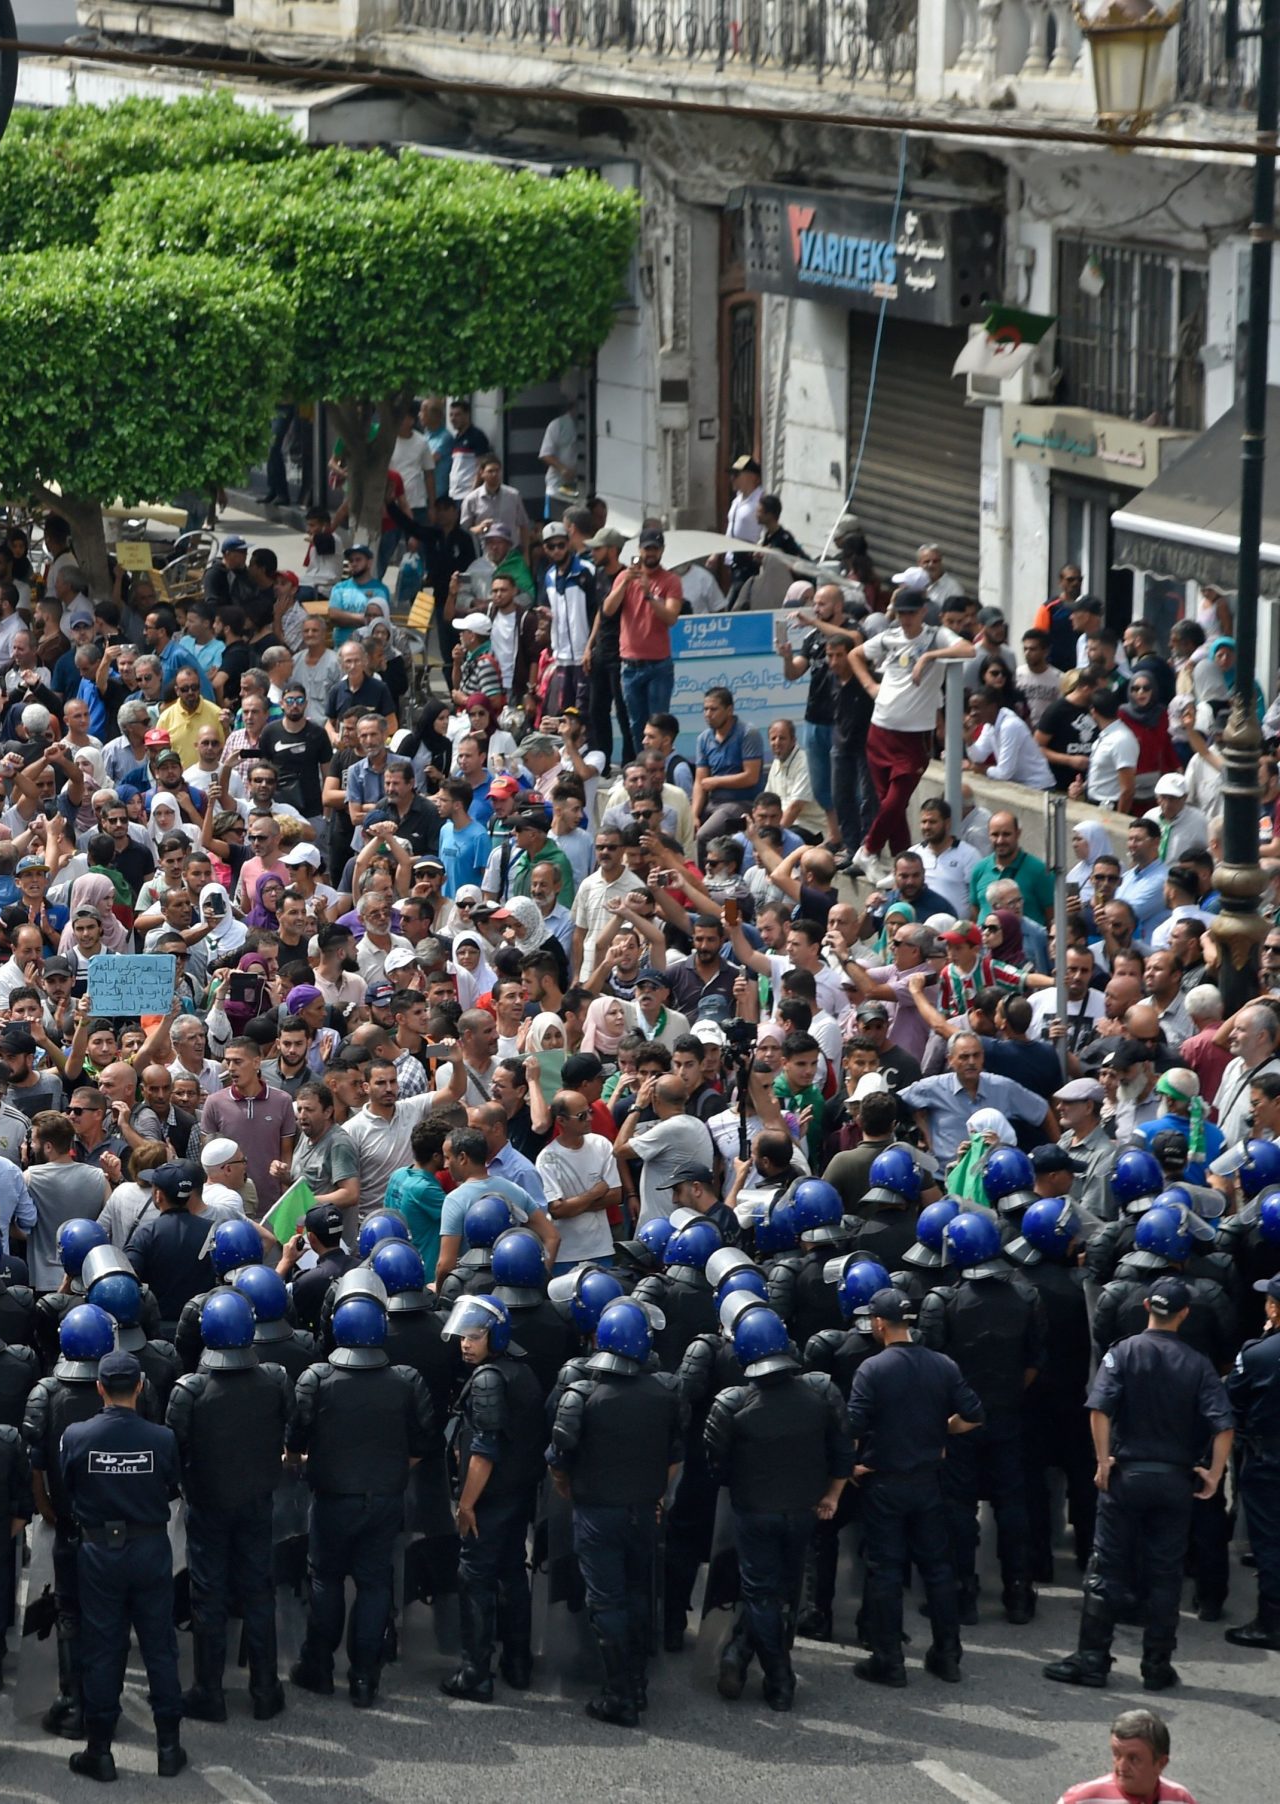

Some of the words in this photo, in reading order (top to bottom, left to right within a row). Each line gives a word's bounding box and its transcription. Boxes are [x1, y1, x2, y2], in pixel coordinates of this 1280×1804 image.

[800, 229, 897, 285] VARITEKS
[683, 617, 732, 639] تافورة
[687, 638, 729, 649] Tafourah
[95, 1453, 148, 1466] شرطة
